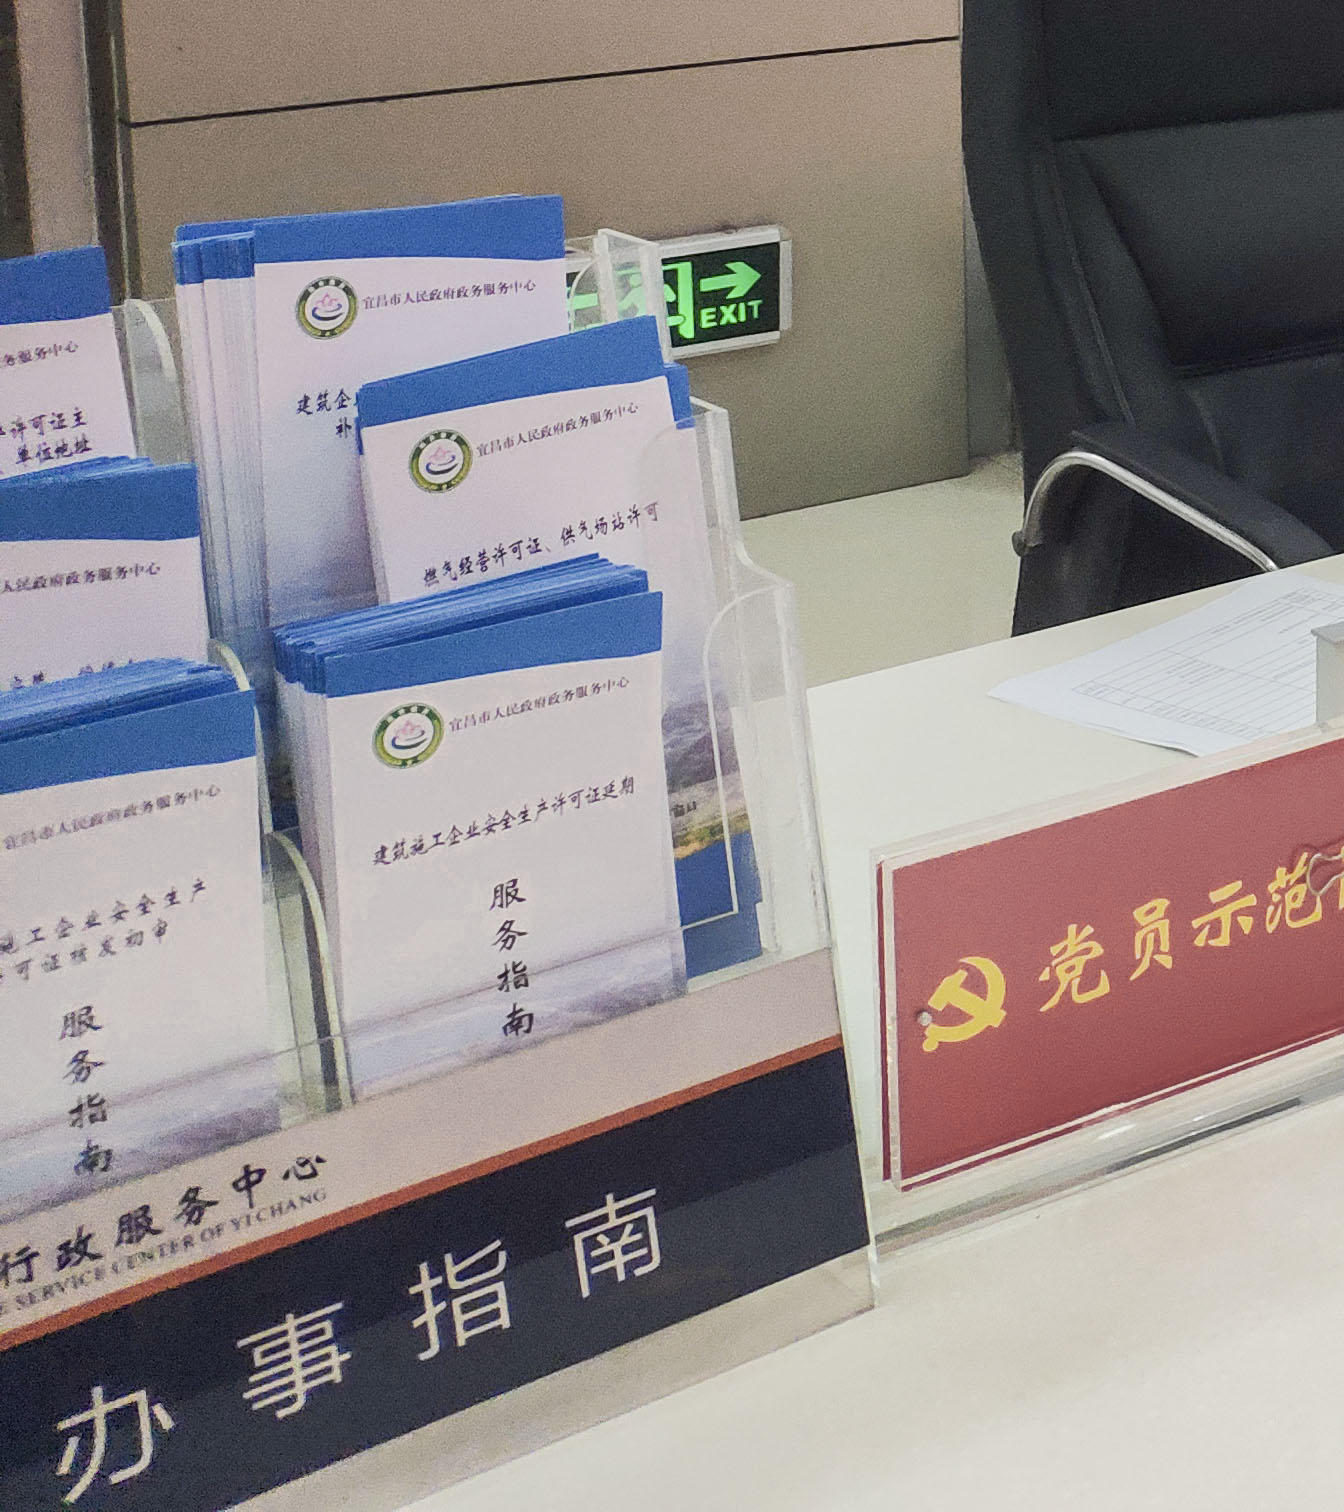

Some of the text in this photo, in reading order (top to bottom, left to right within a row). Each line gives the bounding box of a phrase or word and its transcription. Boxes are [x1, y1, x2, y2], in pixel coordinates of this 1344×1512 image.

[363, 279, 537, 310] 宜昌市人民政府政务服务中心
[700, 300, 764, 330] EXIT
[0, 340, 79, 368] 务服务中心
[0, 407, 88, 440] 许可证主
[297, 389, 358, 416] 建筑企
[476, 402, 639, 458] 宜昌市人民政府政务服务中心
[448, 675, 630, 733] 宜昌市人民政府政务服务中心
[372, 775, 635, 866] 建筑施工企业安全生产许可证延期
[0, 918, 168, 982] 可证核发初审
[489, 877, 535, 1037] 服务指南
[59, 1005, 114, 1177] 服务指南
[229, 1188, 327, 1231] YICHANG
[54, 1185, 663, 1505] 办事指南
